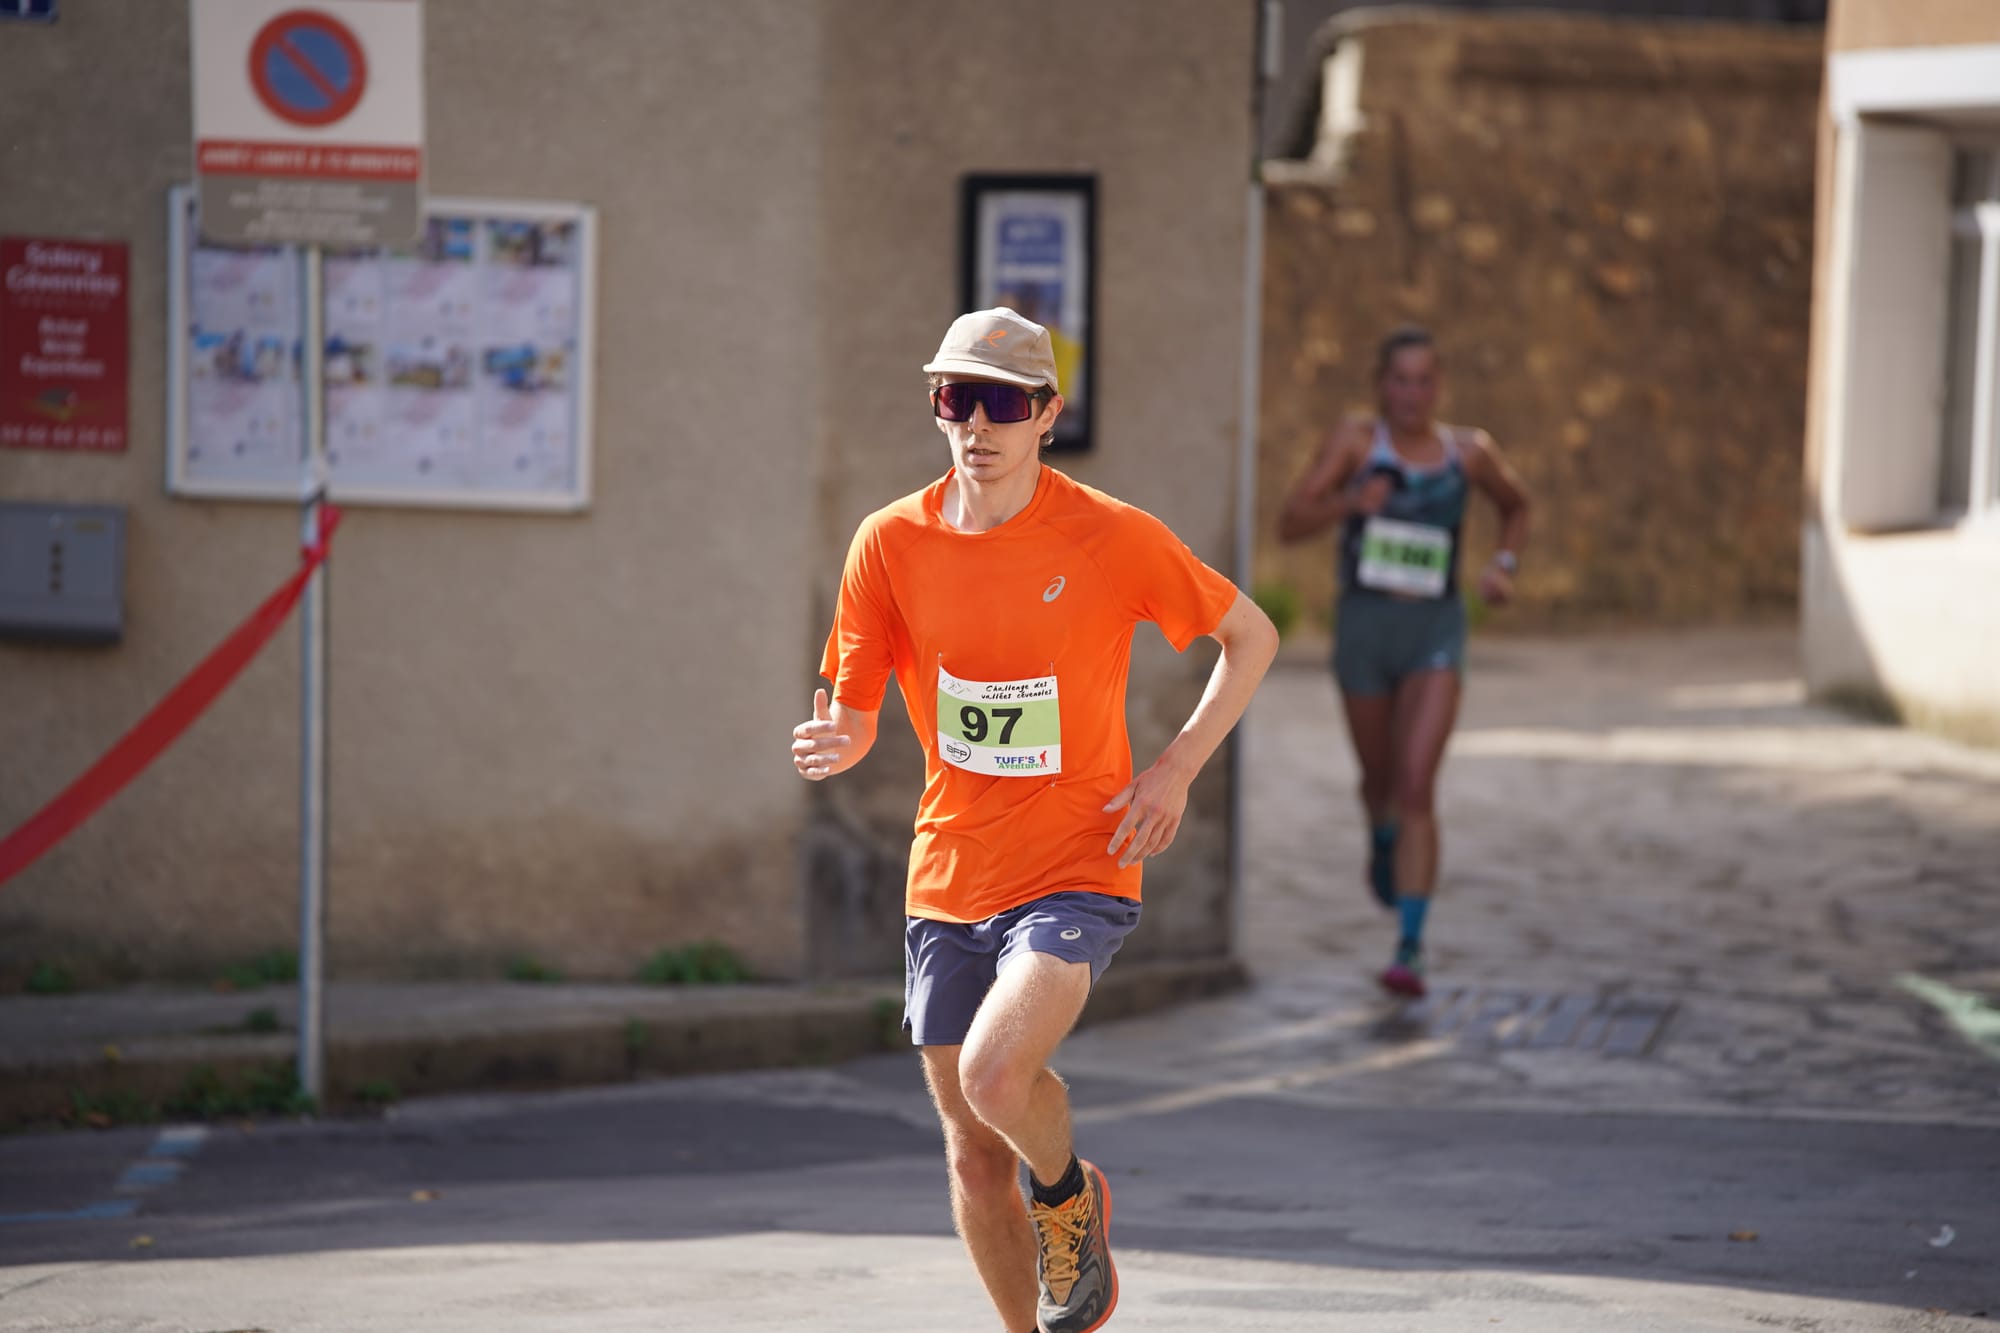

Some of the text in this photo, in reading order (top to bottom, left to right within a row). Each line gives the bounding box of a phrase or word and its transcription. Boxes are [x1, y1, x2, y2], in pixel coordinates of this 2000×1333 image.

[986, 681, 1048, 693] Challenge des
[981, 689, 1052, 700] vallées cévenoles
[960, 705, 1023, 745] 97
[994, 756, 1036, 764] TUFF'S
